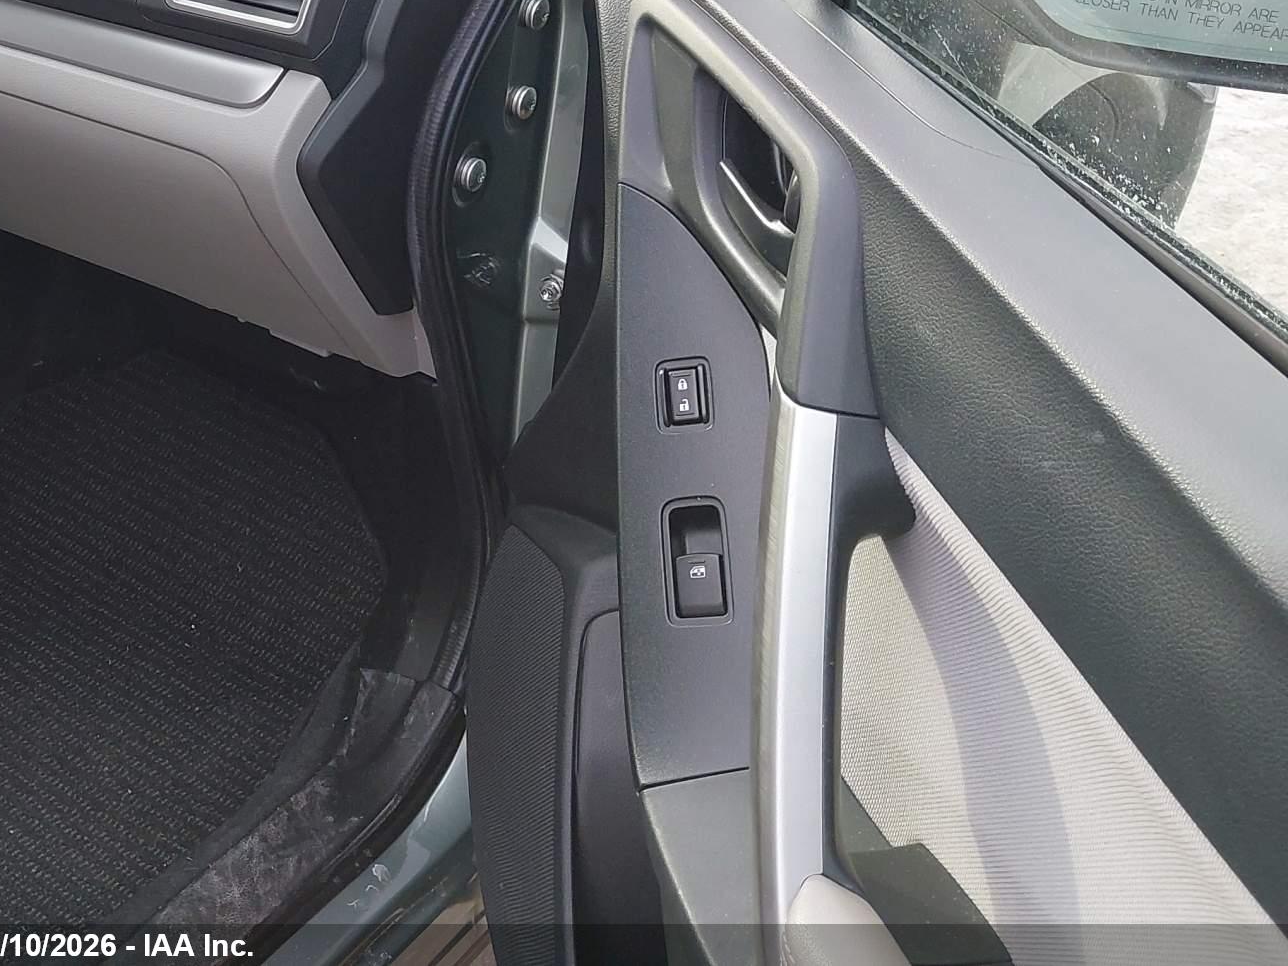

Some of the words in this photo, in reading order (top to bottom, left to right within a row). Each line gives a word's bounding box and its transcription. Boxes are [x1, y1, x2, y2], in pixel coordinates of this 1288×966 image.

[1140, 2, 1179, 21] THAN
[1187, 11, 1225, 29] THEY
[1248, 7, 1280, 24] ARE
